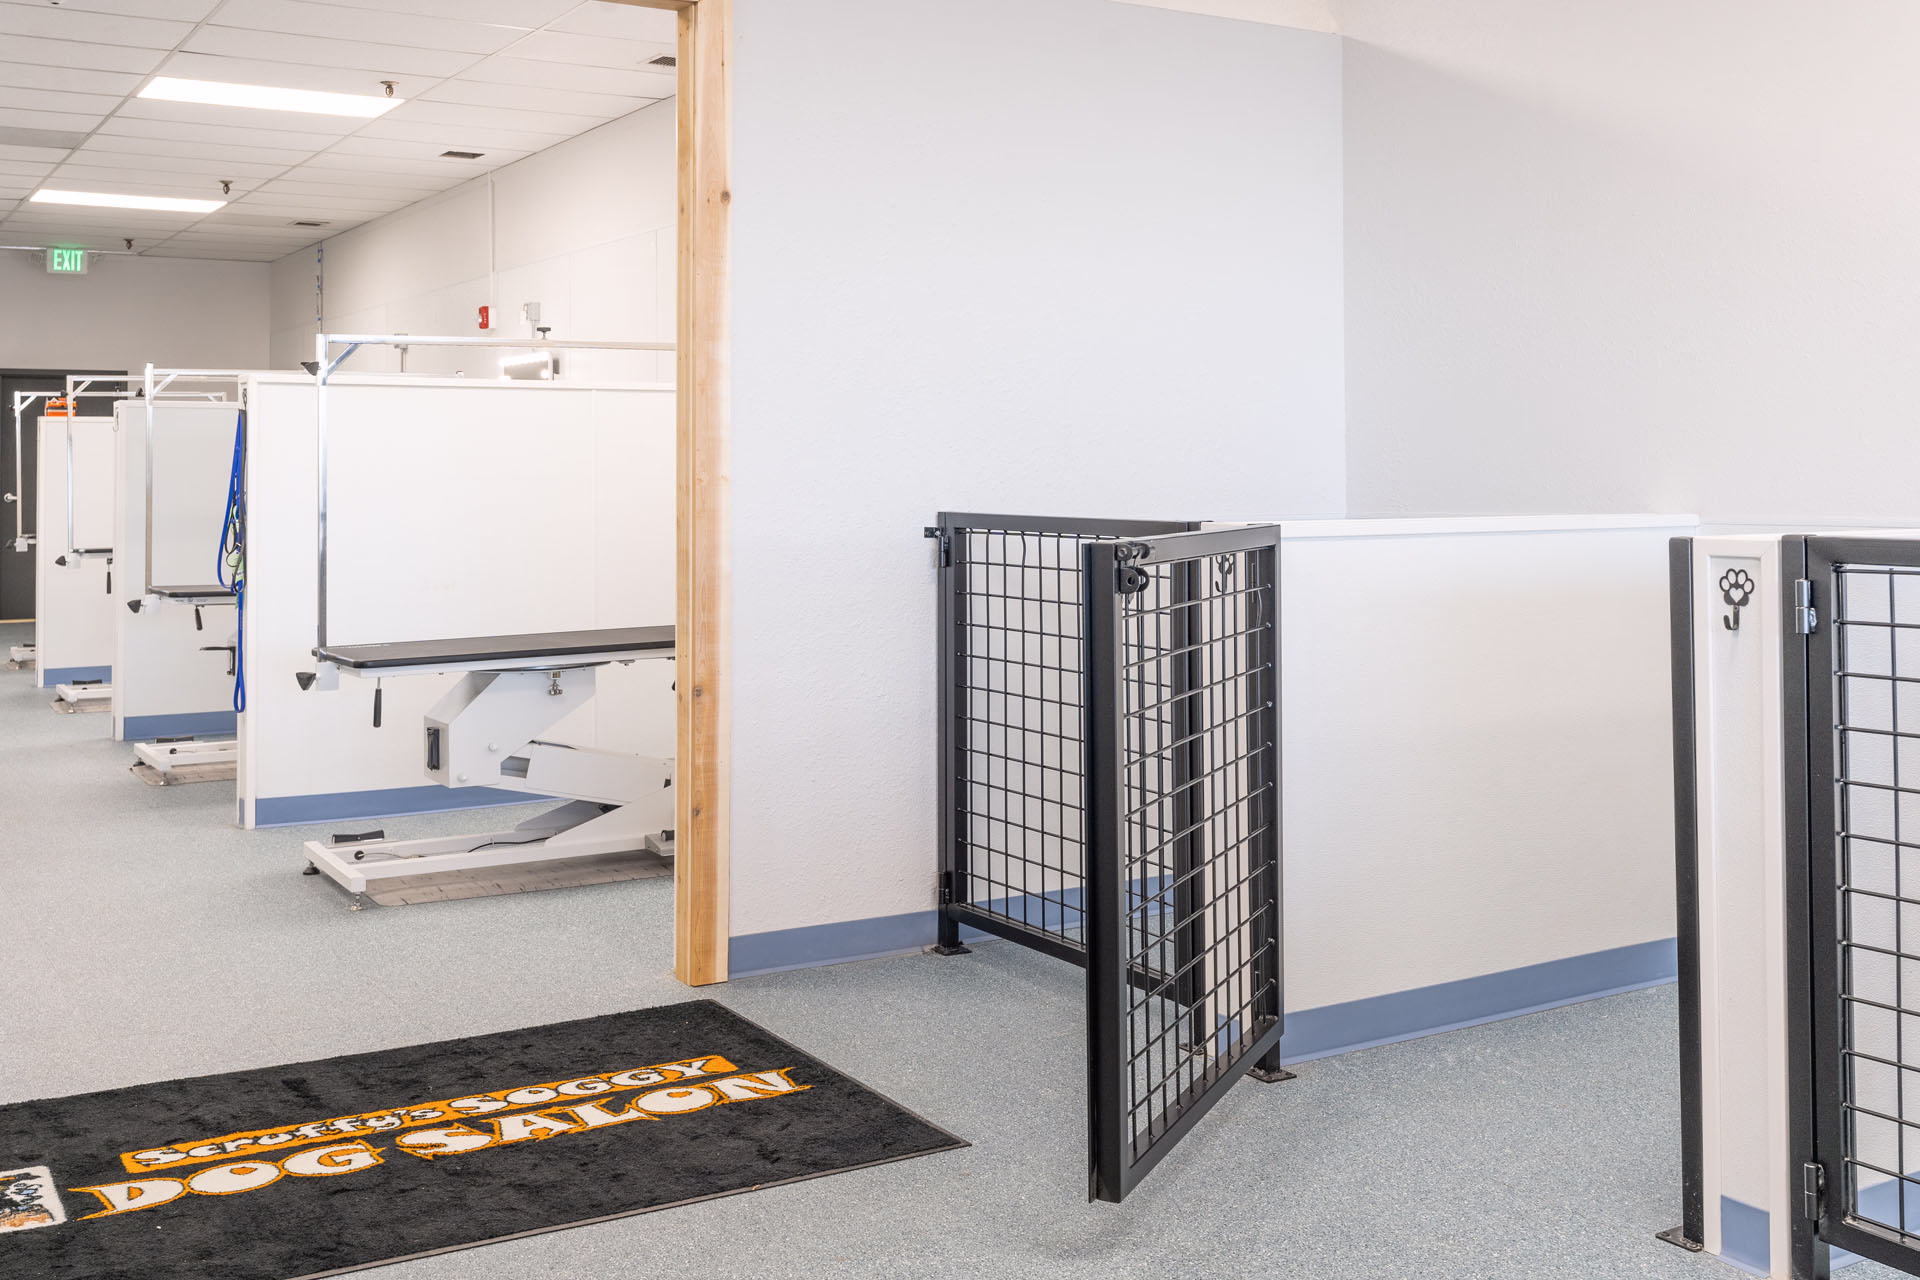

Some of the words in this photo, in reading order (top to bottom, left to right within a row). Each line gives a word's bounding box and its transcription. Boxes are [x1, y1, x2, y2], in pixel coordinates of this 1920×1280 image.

[52, 248, 84, 272] EXIT
[68, 1139, 386, 1221] DOG
[395, 1066, 816, 1160] SALON
[131, 1107, 445, 1167] Scruffy's
[447, 1058, 712, 1115] SOGGY
